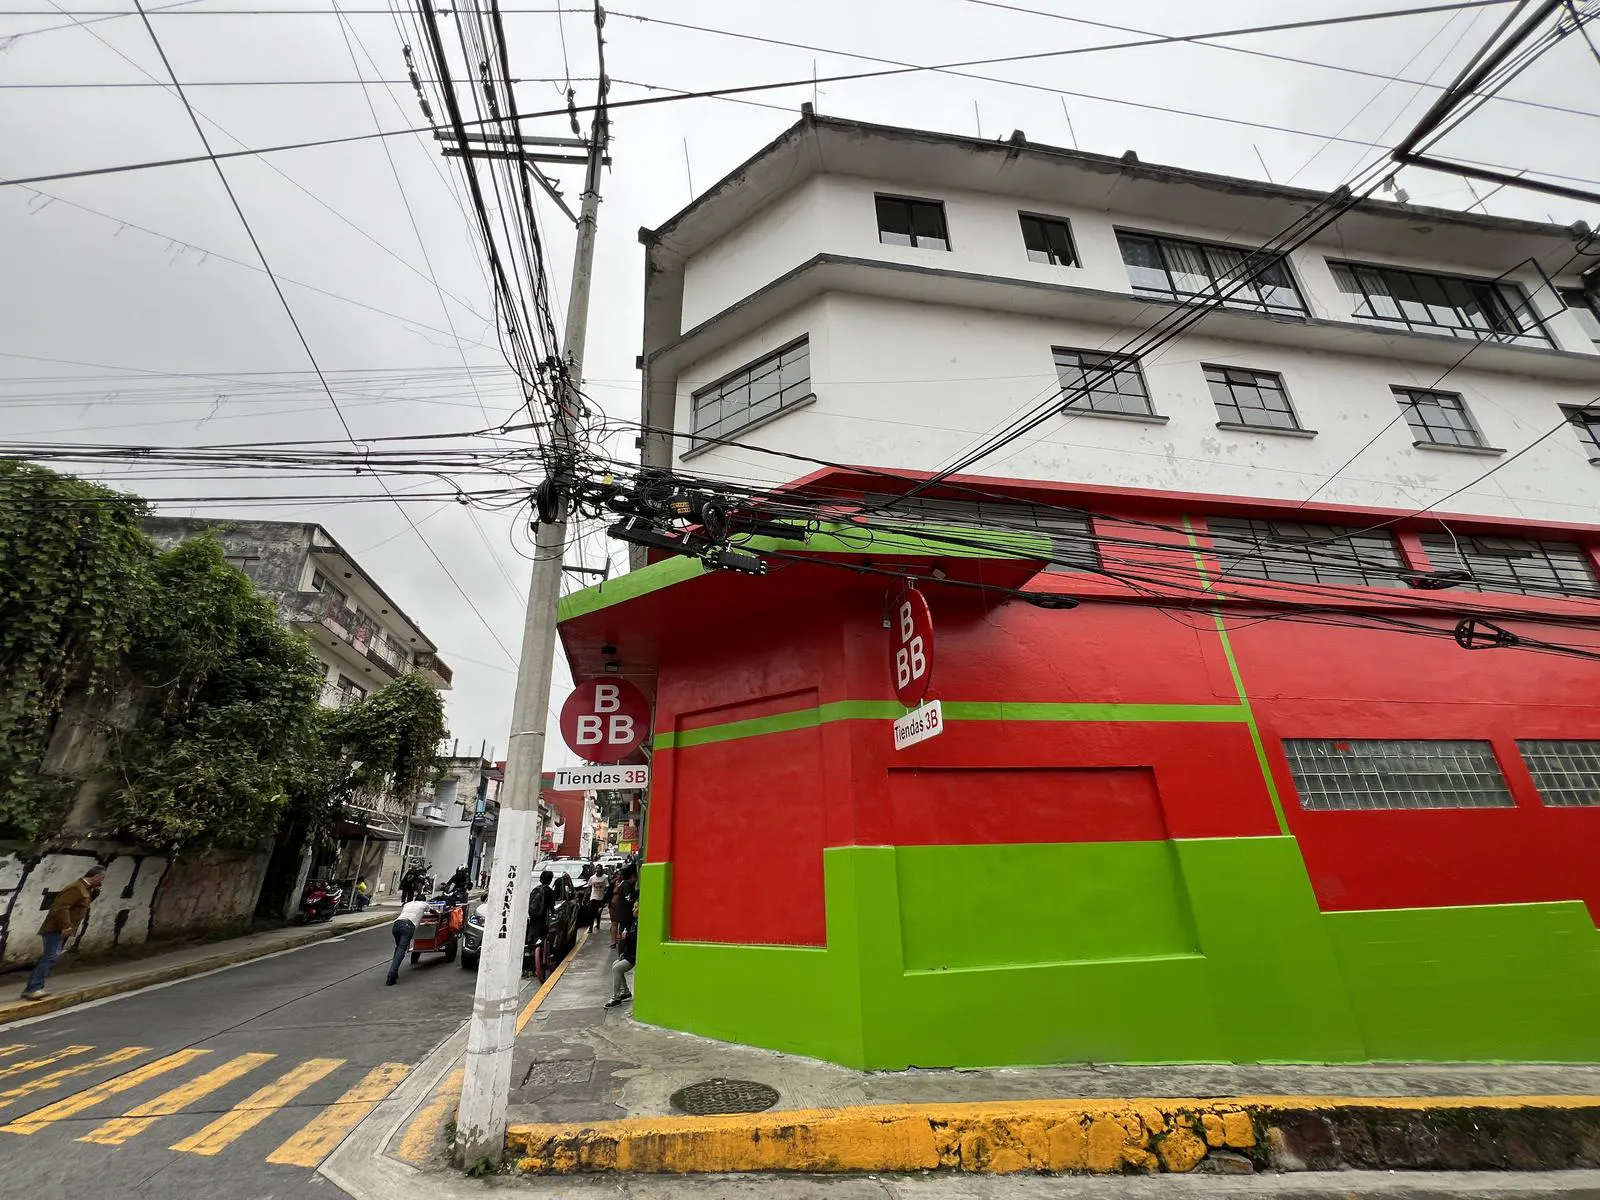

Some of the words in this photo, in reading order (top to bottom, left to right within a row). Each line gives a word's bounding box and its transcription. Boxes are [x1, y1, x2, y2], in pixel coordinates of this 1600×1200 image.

[900, 601, 914, 644] B
[896, 636, 926, 690] BB
[594, 684, 621, 713] B
[576, 714, 635, 745] BB
[894, 717, 924, 743] Tiendas
[925, 708, 939, 731] 3B
[557, 771, 620, 785] Tiendas
[624, 770, 647, 784] 3B
[508, 865, 518, 879] NO
[498, 881, 514, 939] ANUNCIAR
